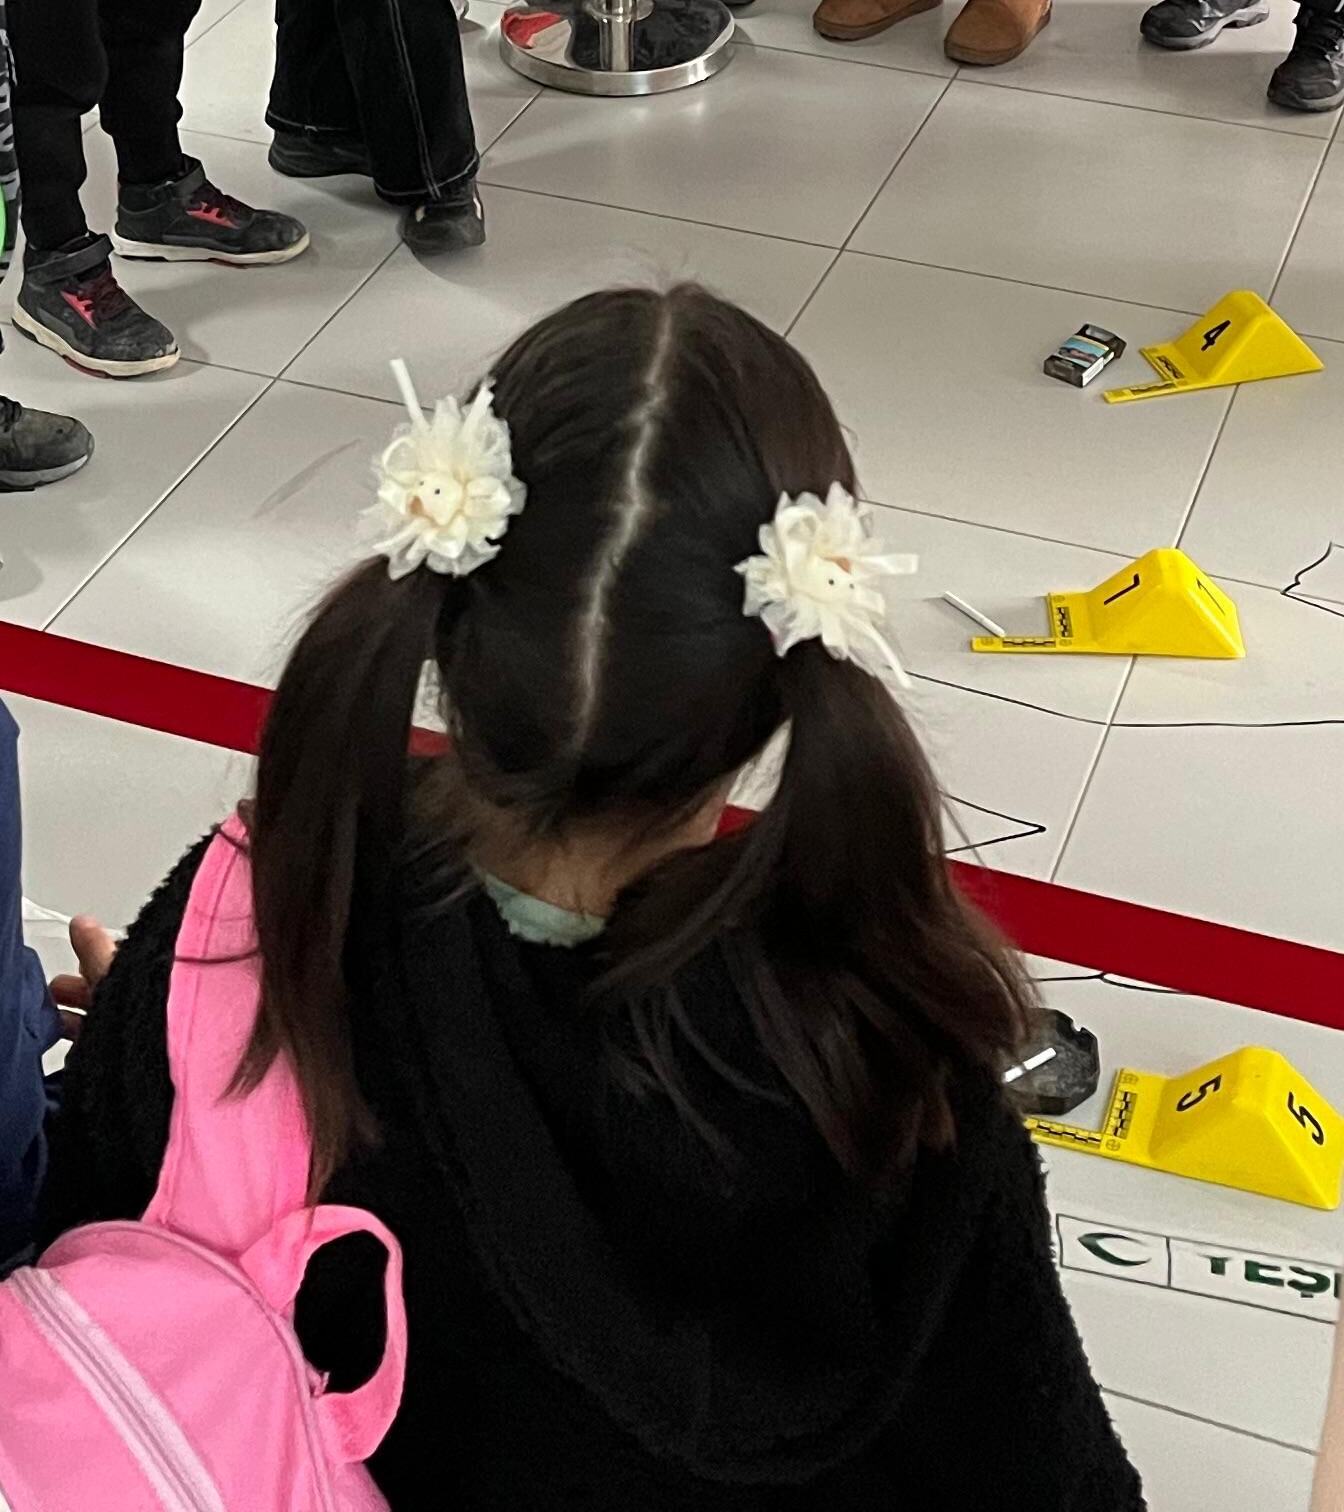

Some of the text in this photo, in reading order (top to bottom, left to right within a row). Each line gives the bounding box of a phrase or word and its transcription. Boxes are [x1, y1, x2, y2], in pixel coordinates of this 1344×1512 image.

[1201, 320, 1231, 353] 4
[1176, 1075, 1221, 1112] 5
[1287, 1091, 1325, 1146] 5
